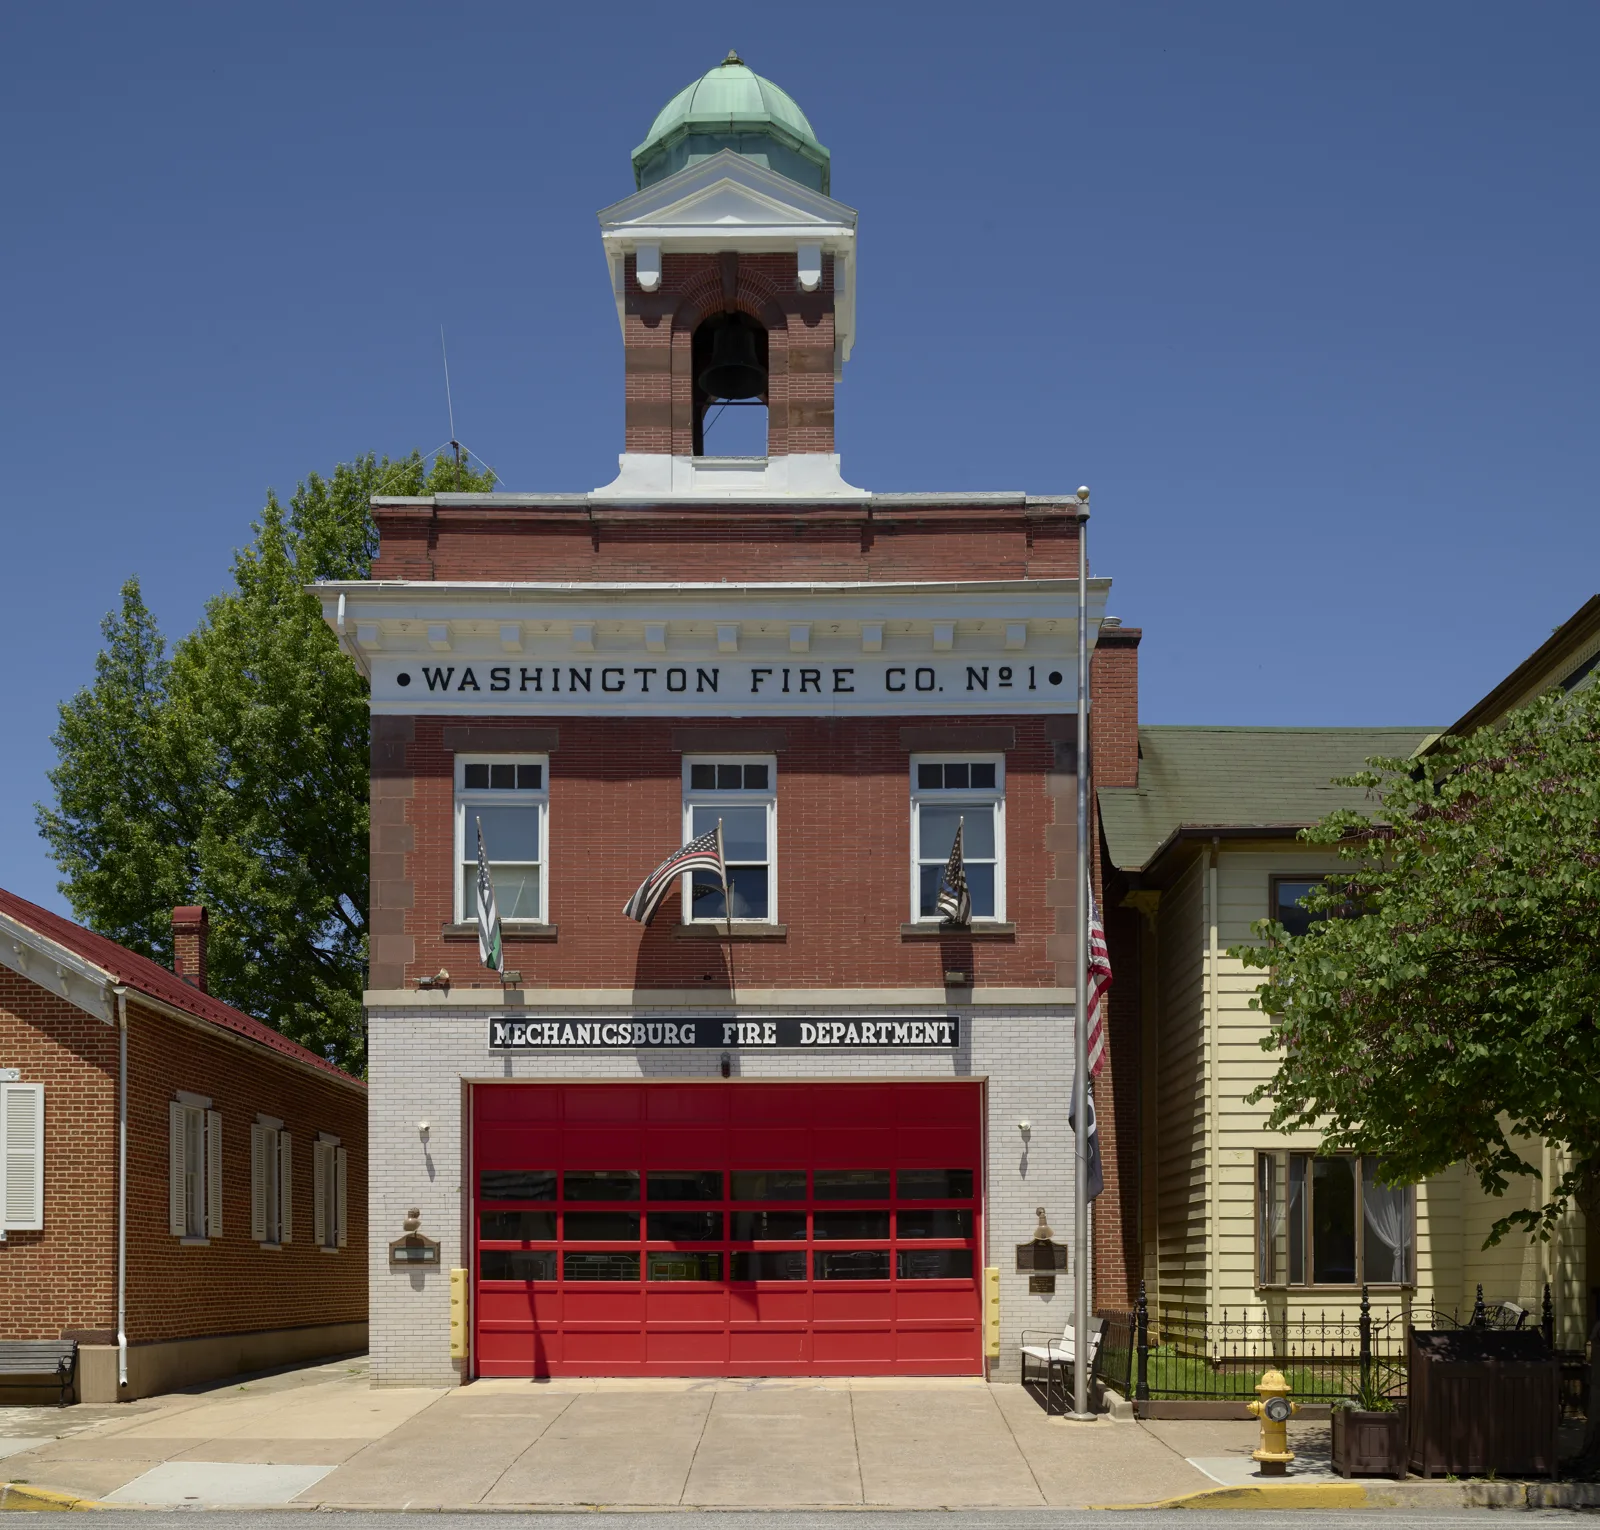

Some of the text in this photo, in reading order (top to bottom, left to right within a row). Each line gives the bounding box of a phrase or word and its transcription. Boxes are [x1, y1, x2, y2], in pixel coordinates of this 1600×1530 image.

[421, 667, 720, 693] WASHINGTON
[750, 668, 855, 693] FIRE
[885, 667, 944, 692] CO.
[1028, 665, 1037, 690] 1
[493, 1022, 955, 1045] MECHANICSBURG FIRE DEPARTMENT
